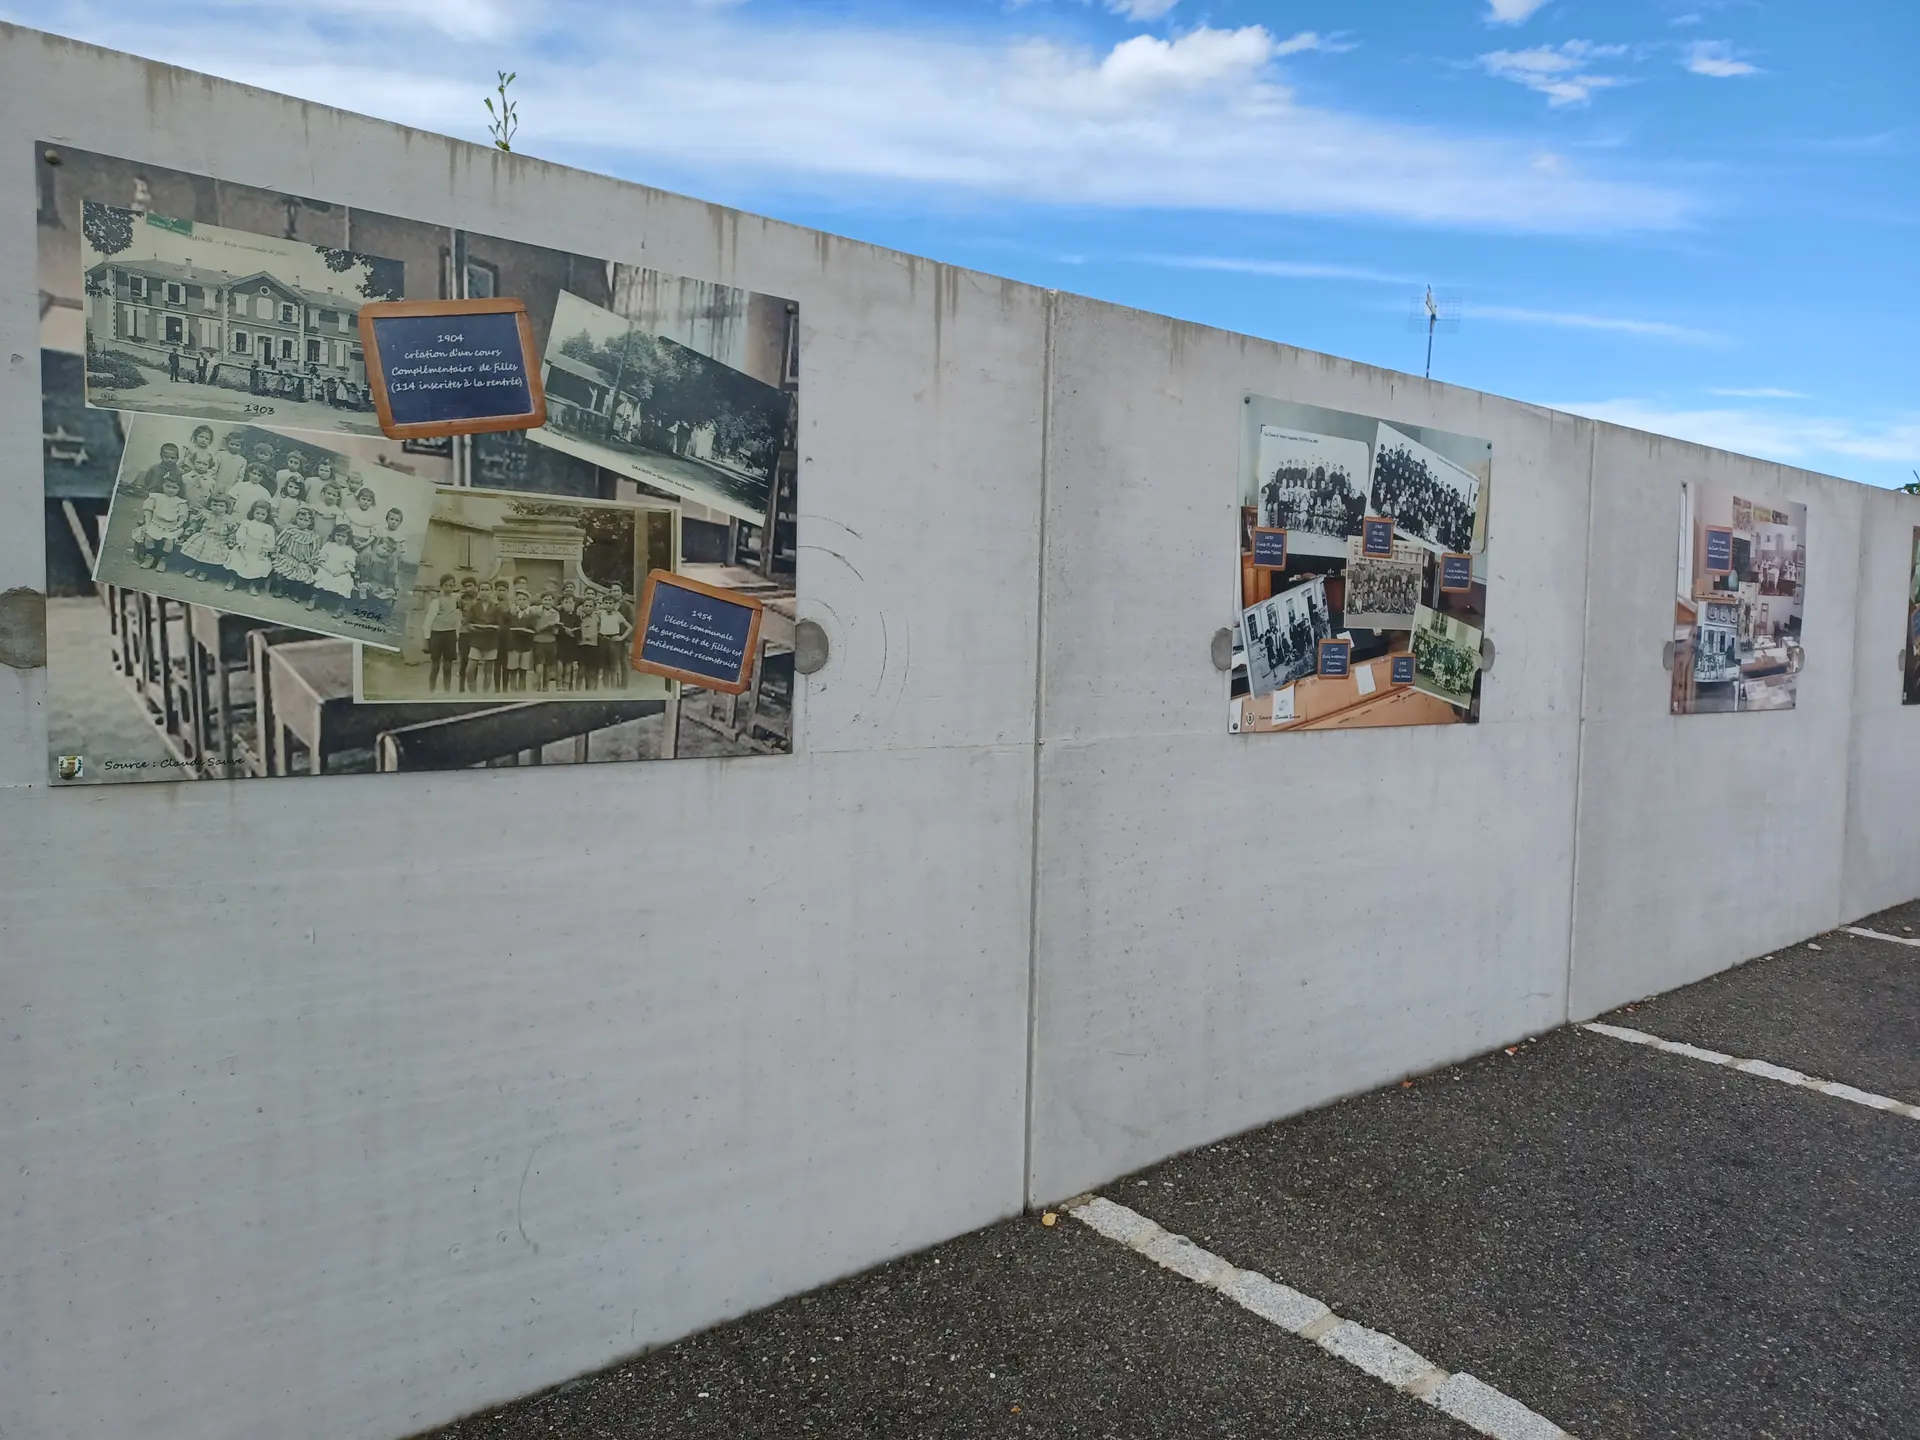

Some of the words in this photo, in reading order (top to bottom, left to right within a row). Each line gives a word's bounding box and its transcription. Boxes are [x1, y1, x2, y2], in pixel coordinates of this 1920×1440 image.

[437, 333, 464, 343] 1904
[404, 349, 448, 359] création
[449, 348, 473, 357] d'un
[391, 363, 474, 377] Complémentaire
[479, 363, 491, 372] de
[493, 362, 519, 374] filles
[391, 380, 416, 394] (114
[419, 380, 462, 391] inscrites
[463, 377, 472, 387] à
[473, 378, 485, 387] la
[486, 376, 523, 388] rentrée)
[244, 404, 275, 415] 1903
[691, 610, 713, 622] 1954
[689, 623, 735, 641] communale
[648, 624, 660, 633] de
[660, 627, 691, 642] garçons
[691, 637, 699, 645] et
[700, 639, 711, 648] de
[711, 641, 732, 654] filles
[731, 649, 743, 657] est
[646, 637, 694, 656] entièrement
[694, 651, 739, 669] reconstruite
[104, 760, 149, 771] Source
[160, 757, 206, 768] Claude
[207, 757, 246, 767] Sauve
